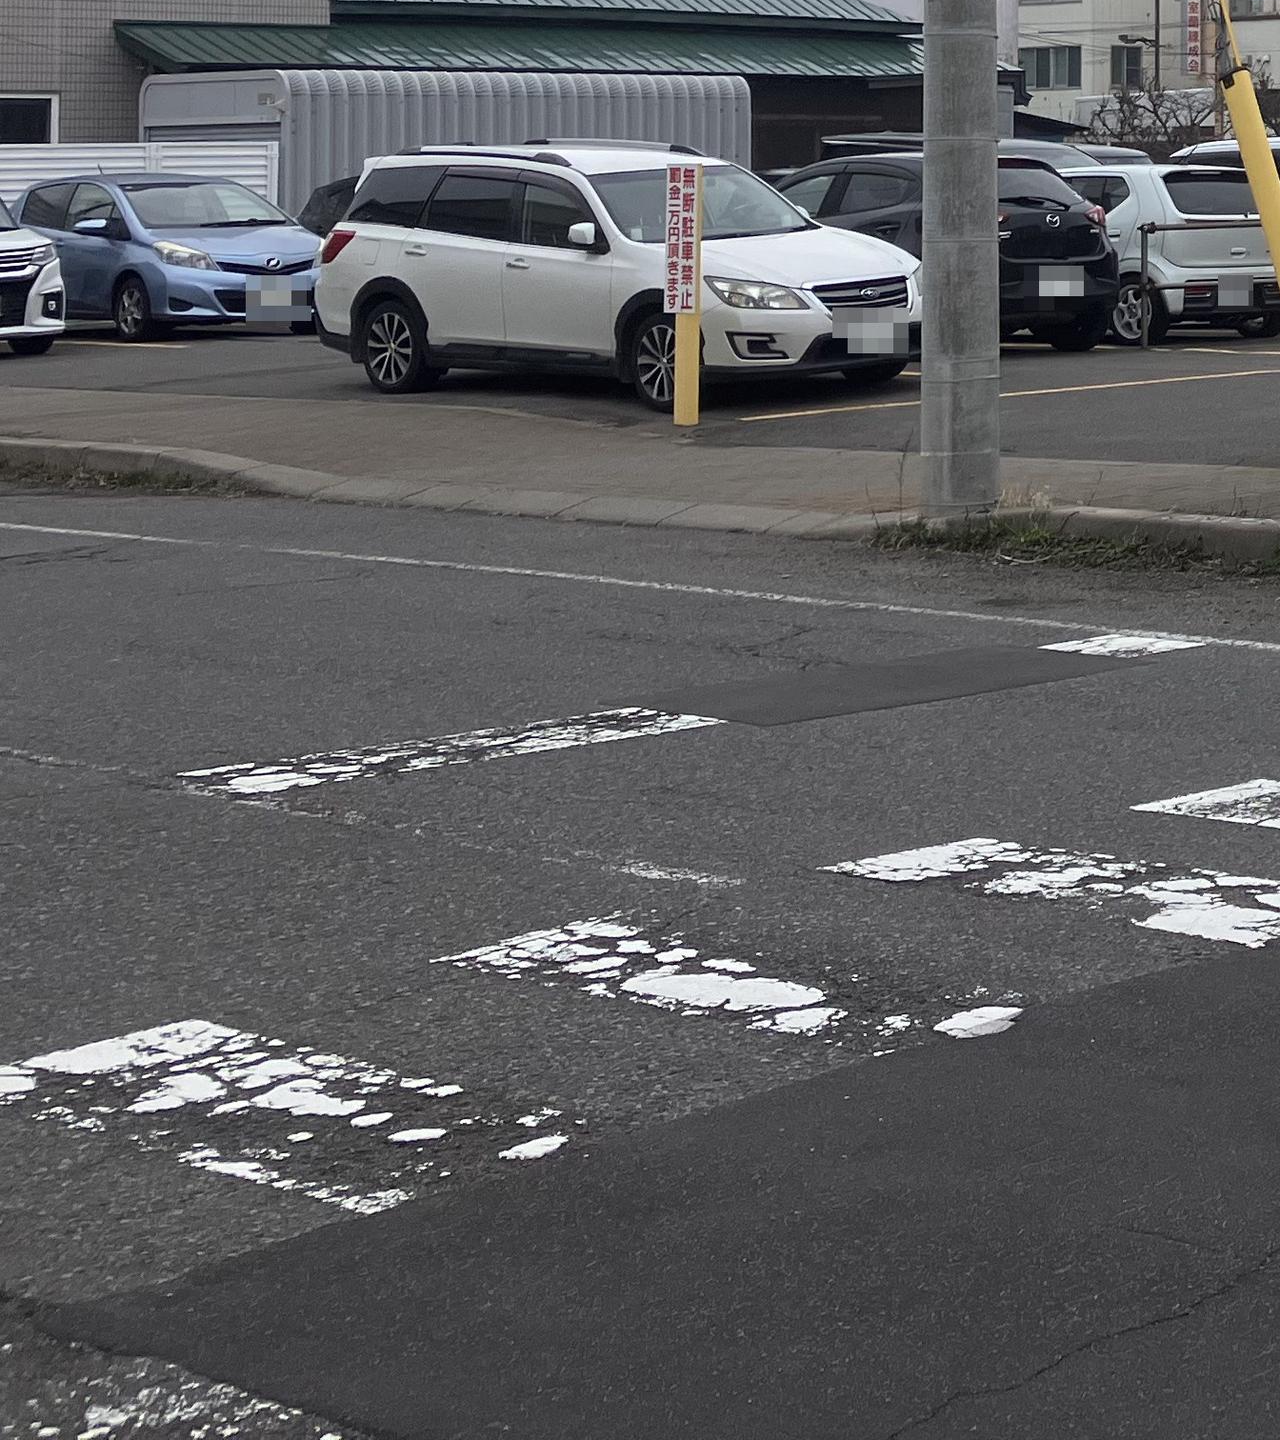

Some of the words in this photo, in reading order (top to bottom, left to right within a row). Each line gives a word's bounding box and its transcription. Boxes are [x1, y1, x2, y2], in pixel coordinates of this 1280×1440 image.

[681, 167, 695, 310] 無断駐車禁止
